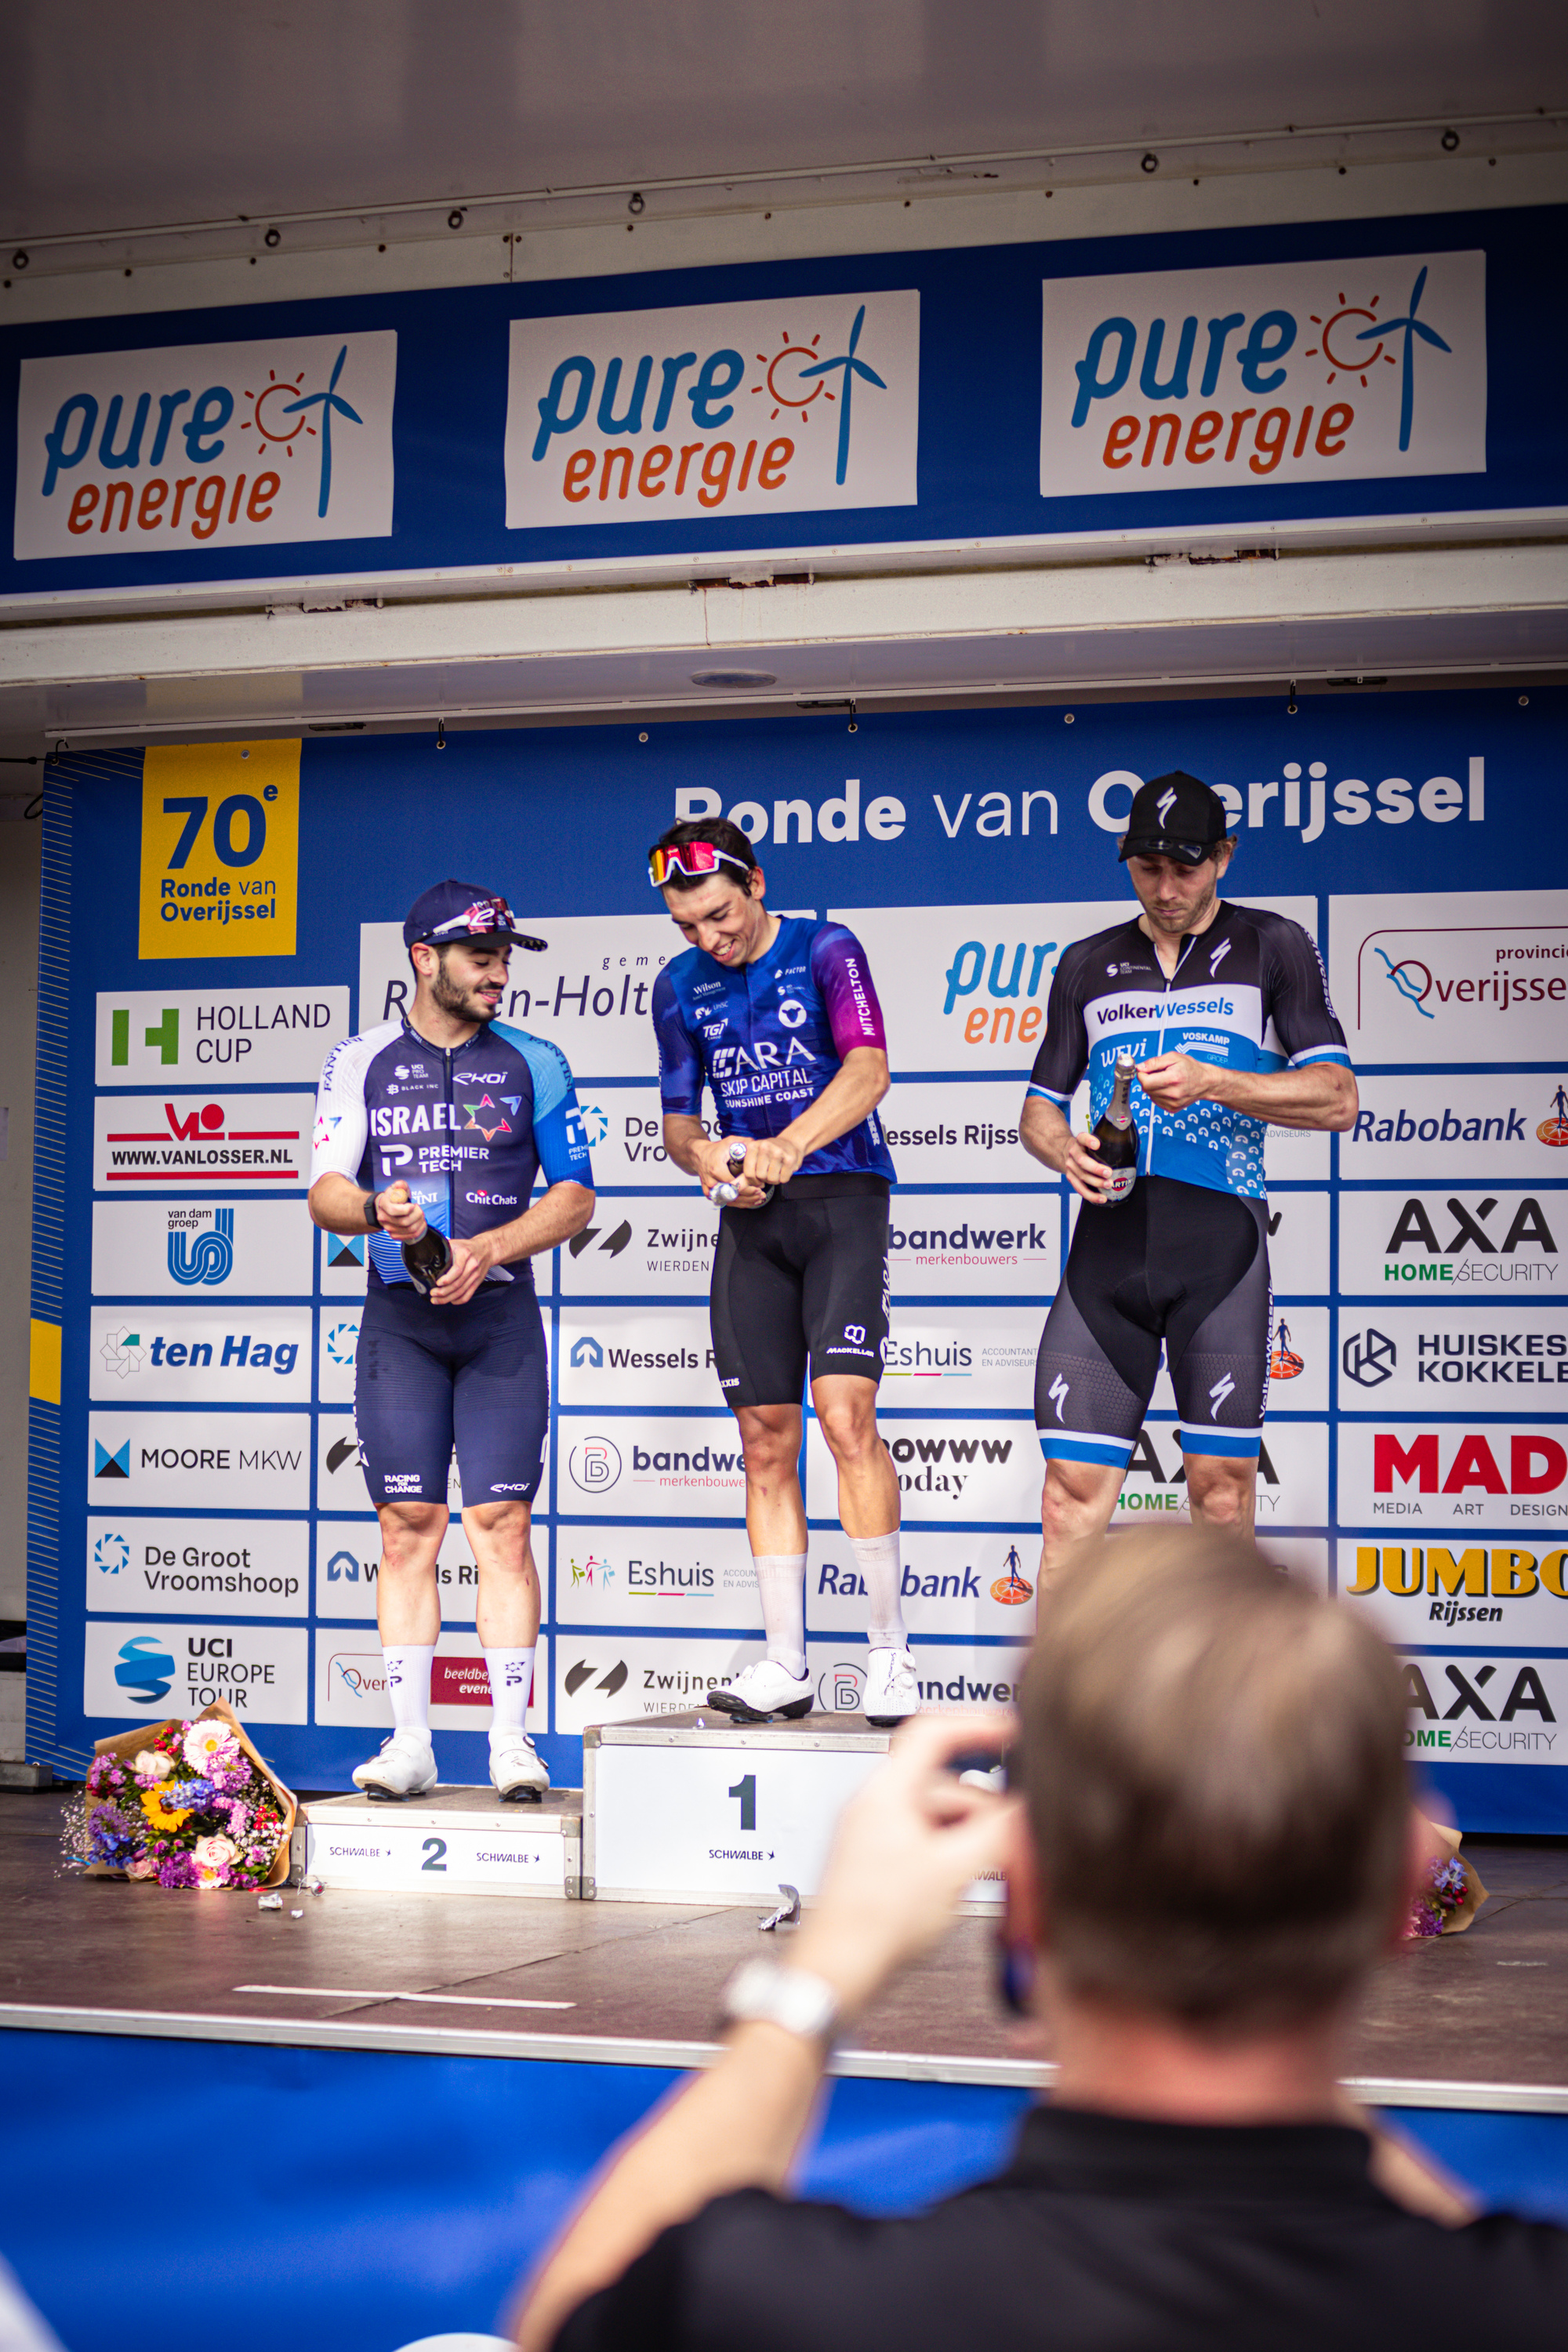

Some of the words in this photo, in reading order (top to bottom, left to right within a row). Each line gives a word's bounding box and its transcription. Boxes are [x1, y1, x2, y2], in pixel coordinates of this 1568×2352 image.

[1071, 309, 1298, 428] pure
[532, 348, 746, 462] pure
[42, 386, 234, 497] pure
[1102, 402, 1355, 475] energie
[562, 437, 796, 508] energie
[67, 471, 281, 540] energie
[932, 789, 1058, 838] van
[1087, 756, 1485, 844] Oerijssel
[161, 877, 230, 898] Ronde
[238, 880, 276, 896] van
[160, 898, 276, 926] Overijssel
[785, 966, 806, 975] FACTOR
[943, 941, 1072, 1015] pur
[693, 981, 721, 995] Wilson
[844, 958, 876, 1036] MITCHELTON
[196, 1004, 331, 1031] HOLLAND
[1097, 997, 1234, 1025] VolkerWessels
[1182, 1033, 1230, 1044] VOSKAMP
[196, 1039, 252, 1065] CUP
[1207, 1054, 1229, 1063] GROEP
[720, 1079, 748, 1097] SKIP
[751, 1068, 813, 1093] CAPITAL
[724, 1094, 772, 1109] SUNSHINE
[775, 1087, 814, 1102] COAST
[370, 1102, 462, 1137] ISRAEL
[625, 1116, 659, 1138] De
[1352, 1107, 1528, 1142] Rabobank
[884, 1124, 957, 1146] essels
[111, 1148, 293, 1167] WWW.VANLOSSER.NL
[418, 1145, 489, 1160] PREMIER
[569, 1152, 587, 1161] TECH
[419, 1159, 463, 1174] TECH
[466, 1190, 491, 1204] Chit
[492, 1194, 517, 1205] Chats
[168, 1210, 187, 1219] van
[189, 1209, 212, 1218] dam
[168, 1219, 198, 1229] groep
[1385, 1198, 1559, 1254] AXA
[887, 1223, 1047, 1251] bandwerk
[647, 1261, 710, 1272] WIERDEN
[915, 1253, 1018, 1266] merkenbouwers
[150, 1336, 215, 1367] ten
[220, 1335, 299, 1375] Hag
[826, 1347, 875, 1357] MACKELLAR
[885, 1341, 972, 1367] Eshuis
[1418, 1334, 1567, 1357] HUISKES
[608, 1348, 699, 1368] Wessels
[141, 1449, 230, 1469] MOORE
[239, 1450, 302, 1471] MKW
[1374, 1434, 1568, 1495] MAD
[384, 1475, 420, 1483] RACING
[385, 1485, 423, 1494] CHANGE
[898, 1465, 970, 1500] oday
[1373, 1502, 1423, 1514] MEDIA
[1453, 1504, 1484, 1515] ART
[1510, 1504, 1568, 1516] DESIGN
[145, 1546, 176, 1566] De
[182, 1547, 251, 1569] Groot
[143, 1570, 299, 1598] Vroomshoop
[628, 1560, 714, 1587] Eshuis
[818, 1564, 982, 1599] Rabank
[1428, 1600, 1504, 1628] Rijssen
[187, 1637, 233, 1658] UCI
[187, 1663, 275, 1685] EUROPE
[187, 1686, 248, 1708] TOUR
[1402, 1663, 1557, 1723] AXA
[728, 1773, 756, 1831] 1
[329, 1846, 380, 1858] SCHWALBE
[421, 1838, 447, 1871] 2
[477, 1852, 529, 1864] SCHWALBE
[709, 1849, 764, 1860] SCHWALBE
